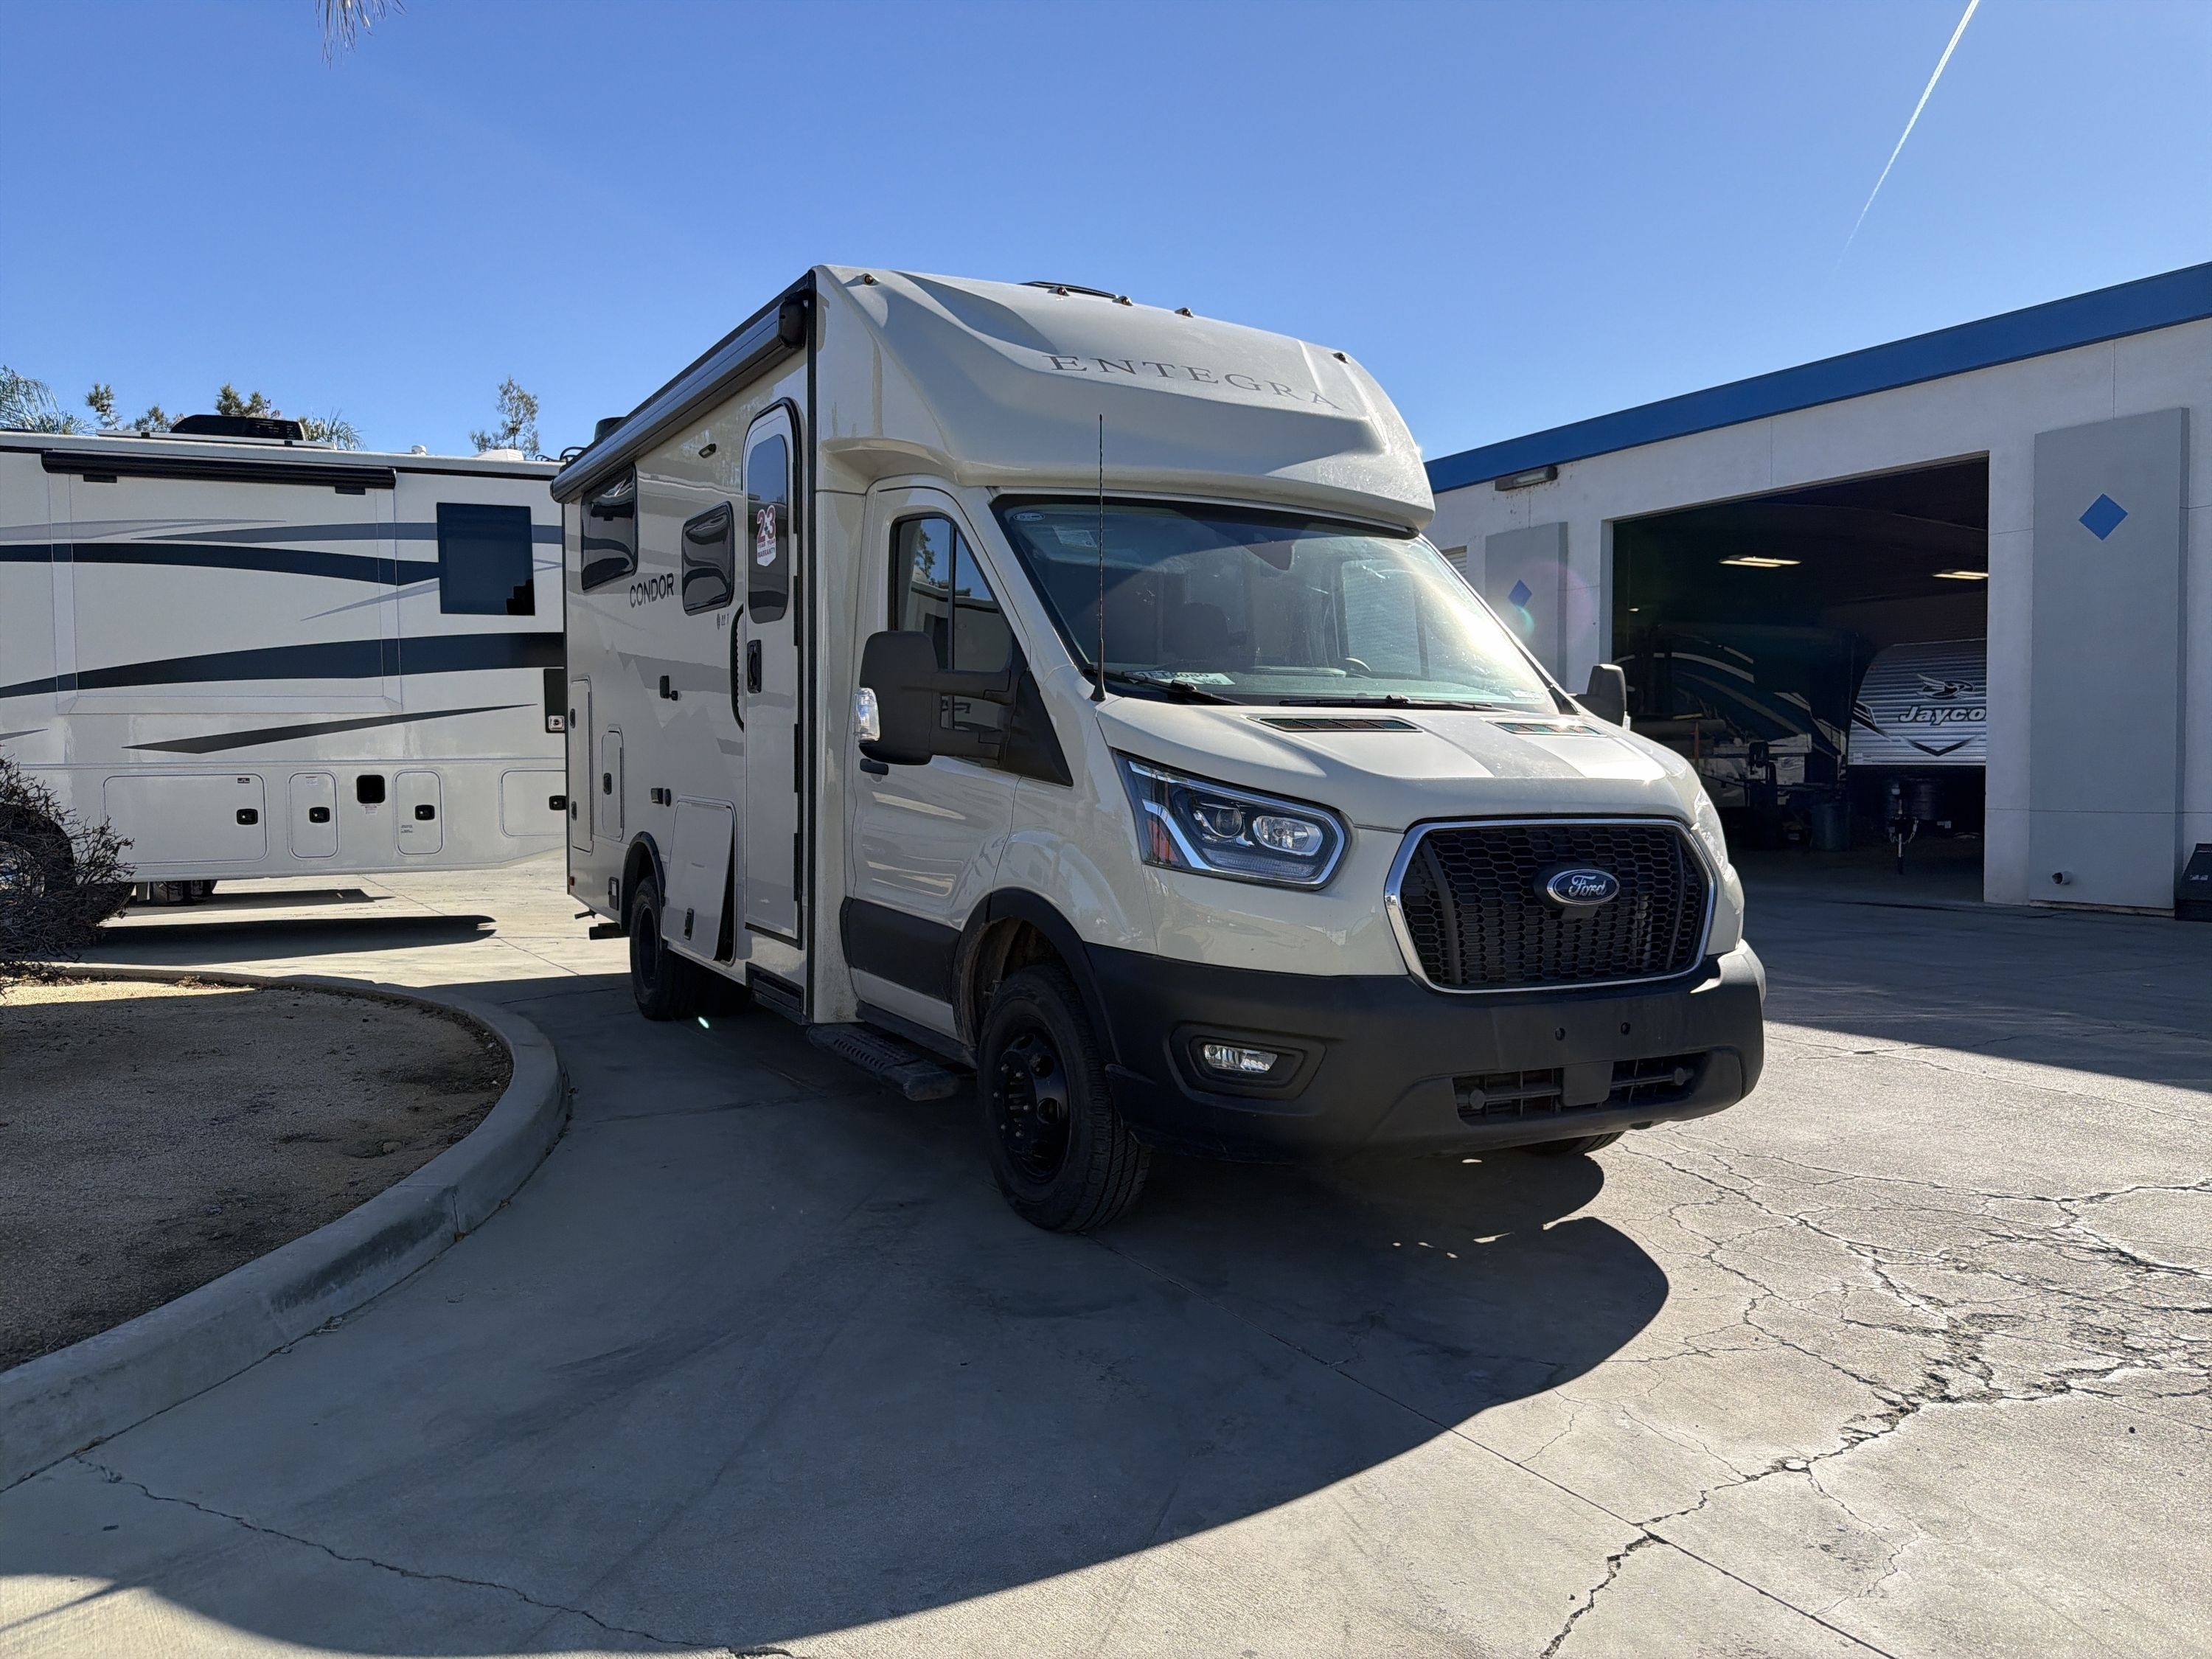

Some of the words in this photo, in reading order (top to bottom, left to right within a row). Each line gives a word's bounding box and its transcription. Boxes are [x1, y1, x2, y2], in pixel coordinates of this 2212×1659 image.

[1043, 355, 1343, 411] ENTEGRA
[630, 572, 675, 608] CONDOR
[1898, 705, 1986, 726] Jayco
[1568, 874, 1607, 897] Ford
